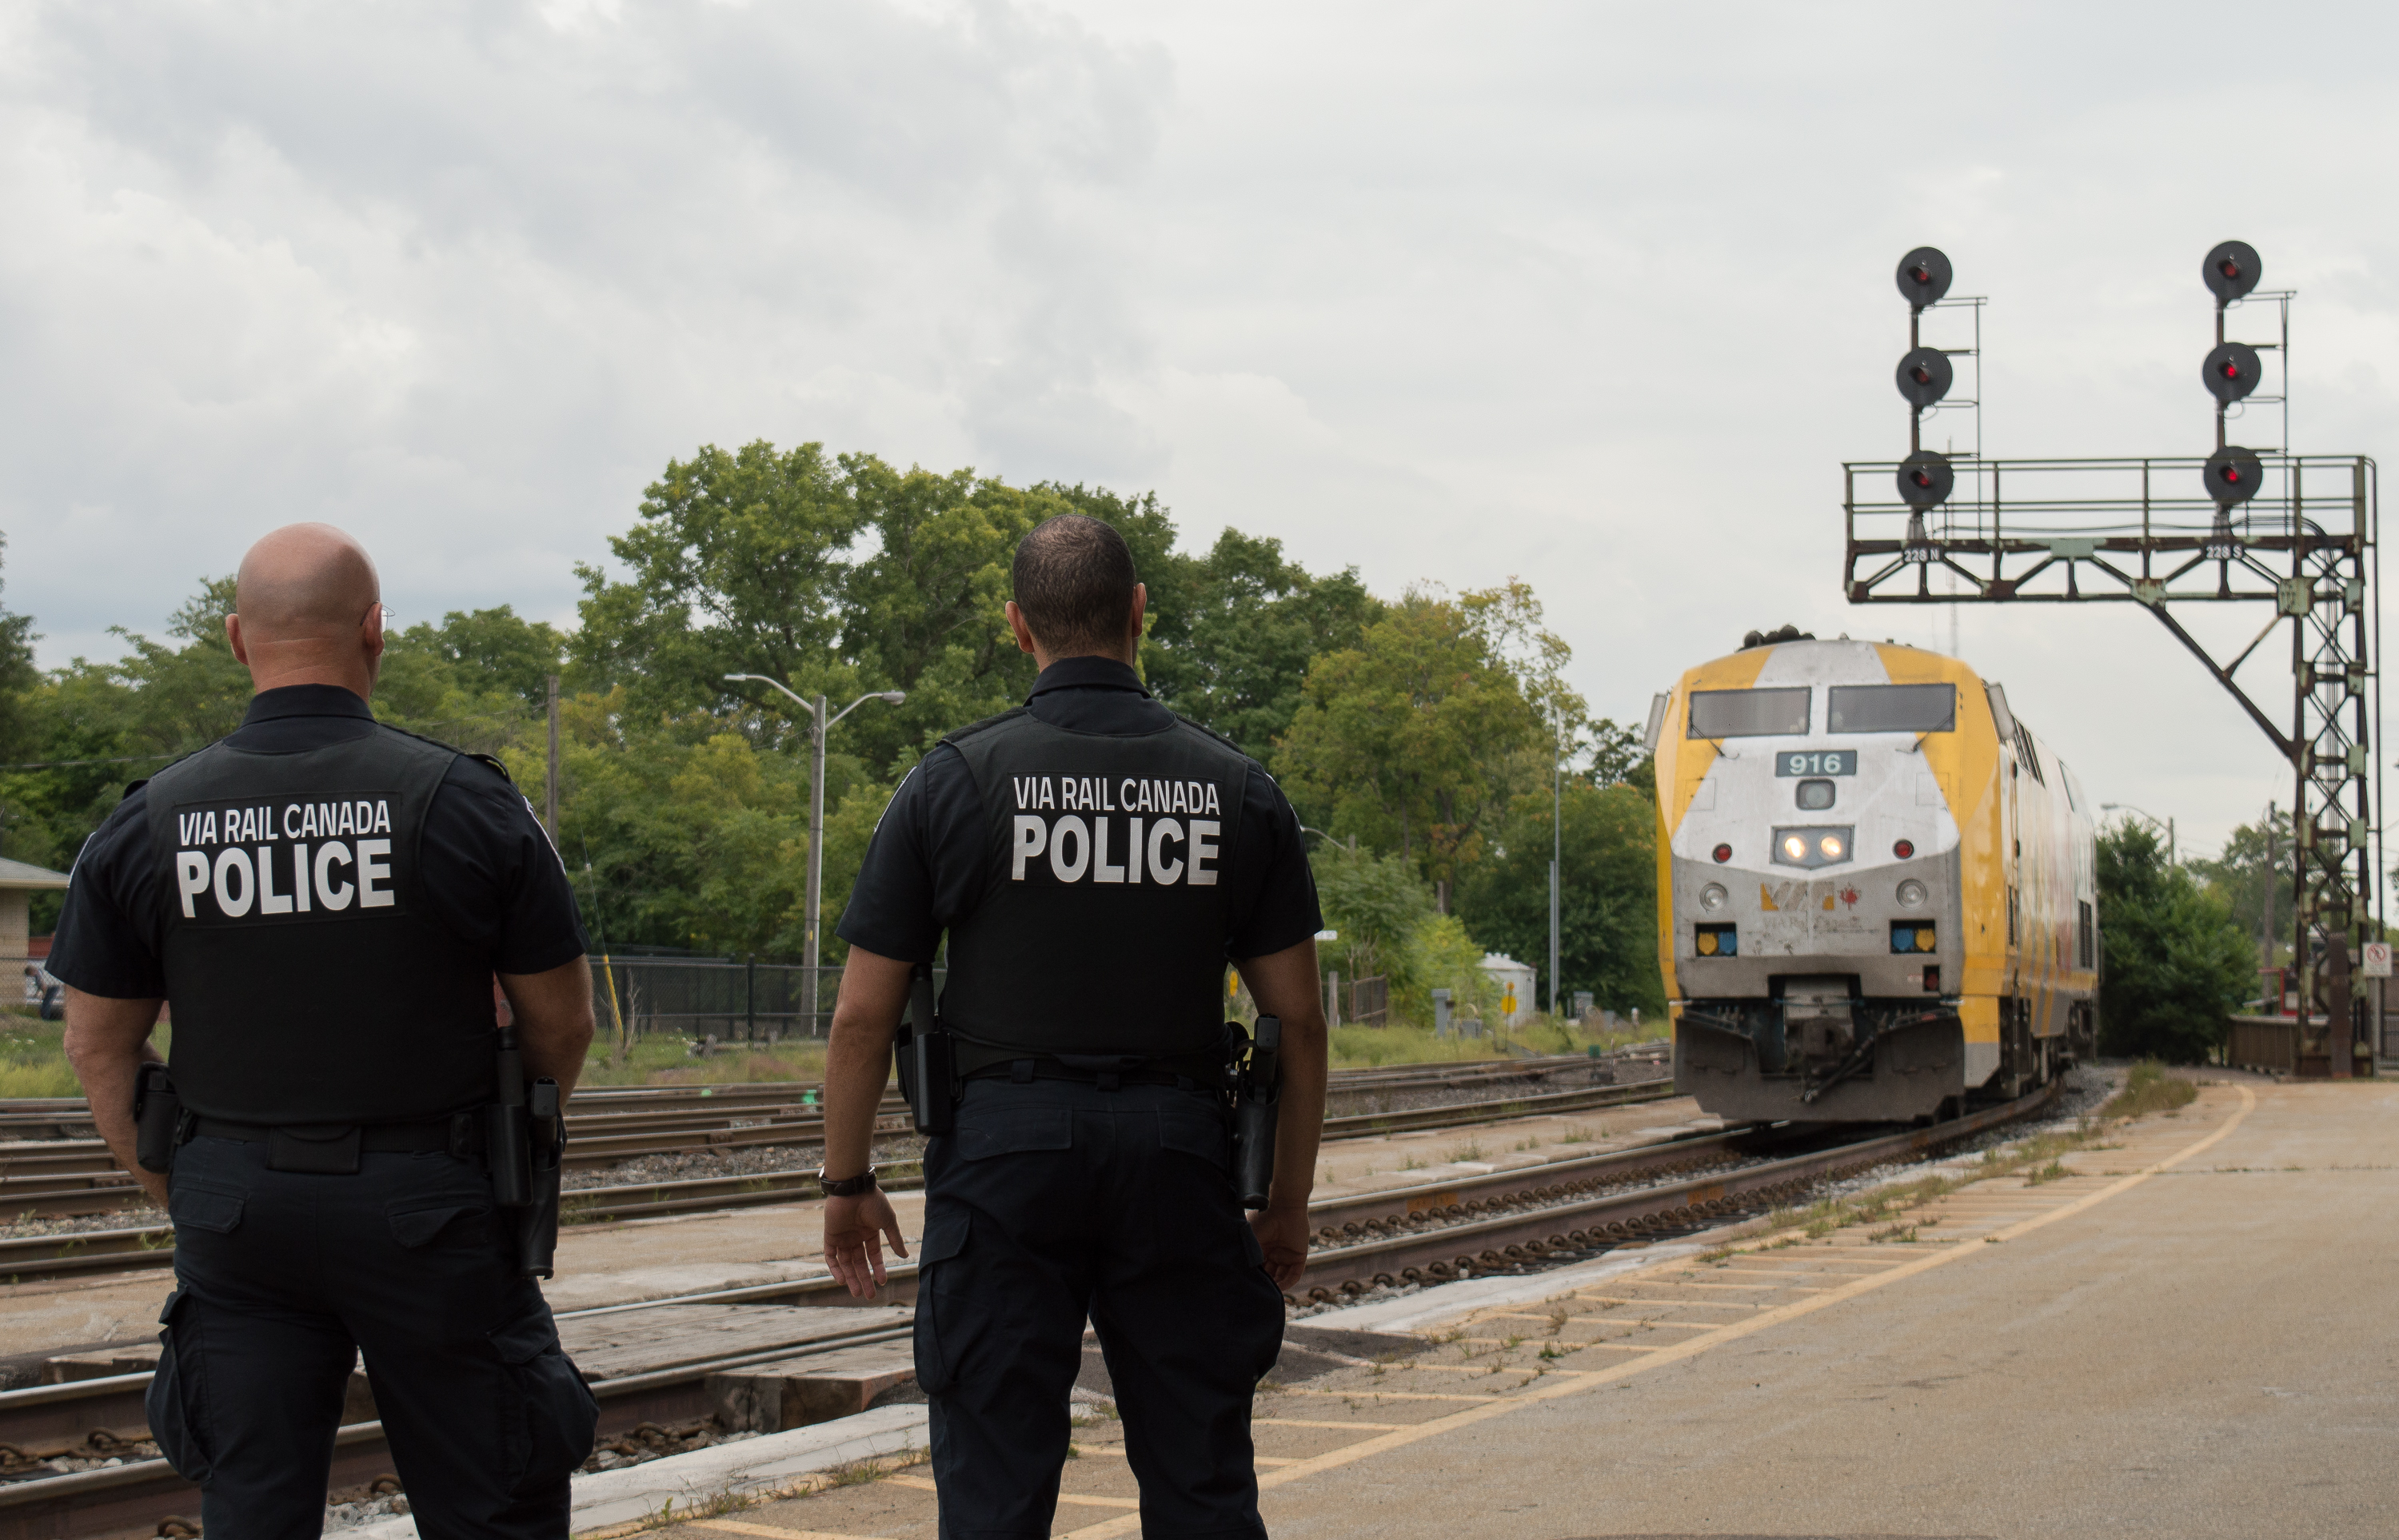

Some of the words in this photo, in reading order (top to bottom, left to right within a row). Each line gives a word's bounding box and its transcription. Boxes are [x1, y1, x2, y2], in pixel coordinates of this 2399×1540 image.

[1904, 548, 1928, 562] 228
[1930, 548, 1940, 561] N
[2206, 545, 2231, 559] 228
[2233, 545, 2242, 559] S
[1789, 753, 1842, 775] 916
[1014, 776, 1056, 810] VIA
[1062, 777, 1116, 811] RAIL
[1120, 778, 1220, 816] CANADA
[180, 812, 218, 846] VIA
[225, 806, 278, 844] RAIL
[283, 800, 392, 840] CANADA
[1012, 814, 1221, 886] POLICE
[177, 838, 395, 918] POLICE
